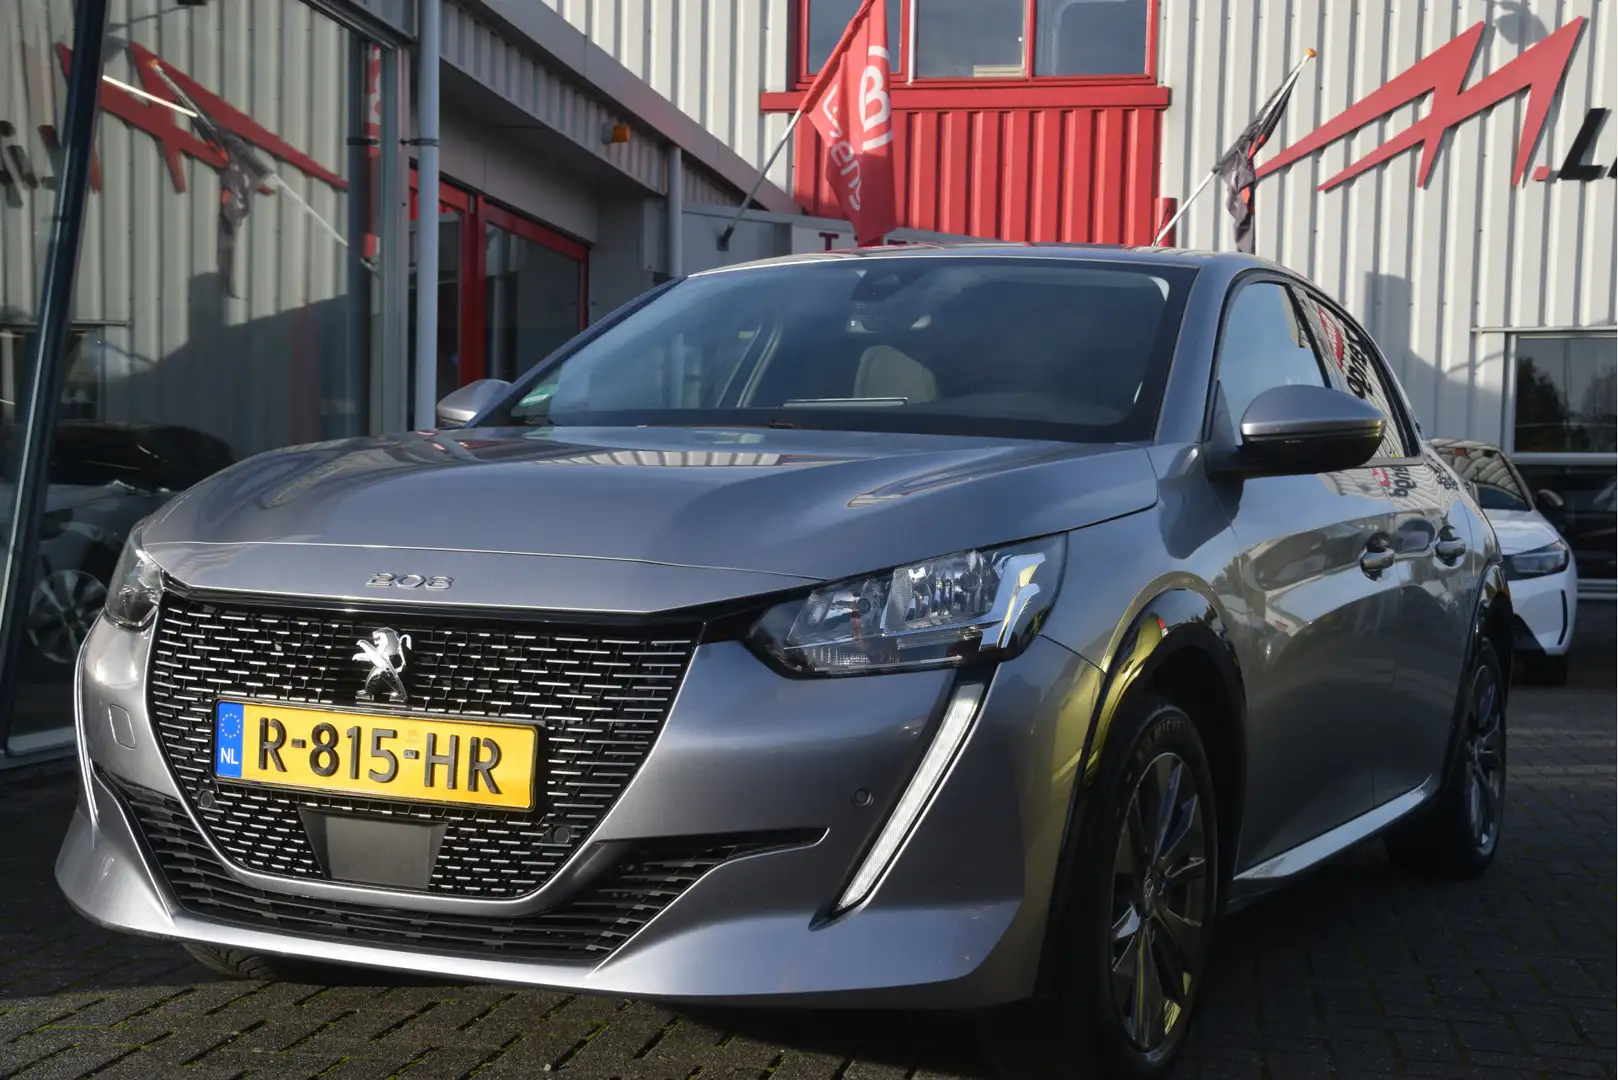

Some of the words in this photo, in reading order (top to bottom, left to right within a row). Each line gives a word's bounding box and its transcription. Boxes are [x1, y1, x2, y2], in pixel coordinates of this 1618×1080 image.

[366, 572, 454, 591] 208
[220, 747, 239, 766] NL
[258, 717, 503, 794] R-815-HR
